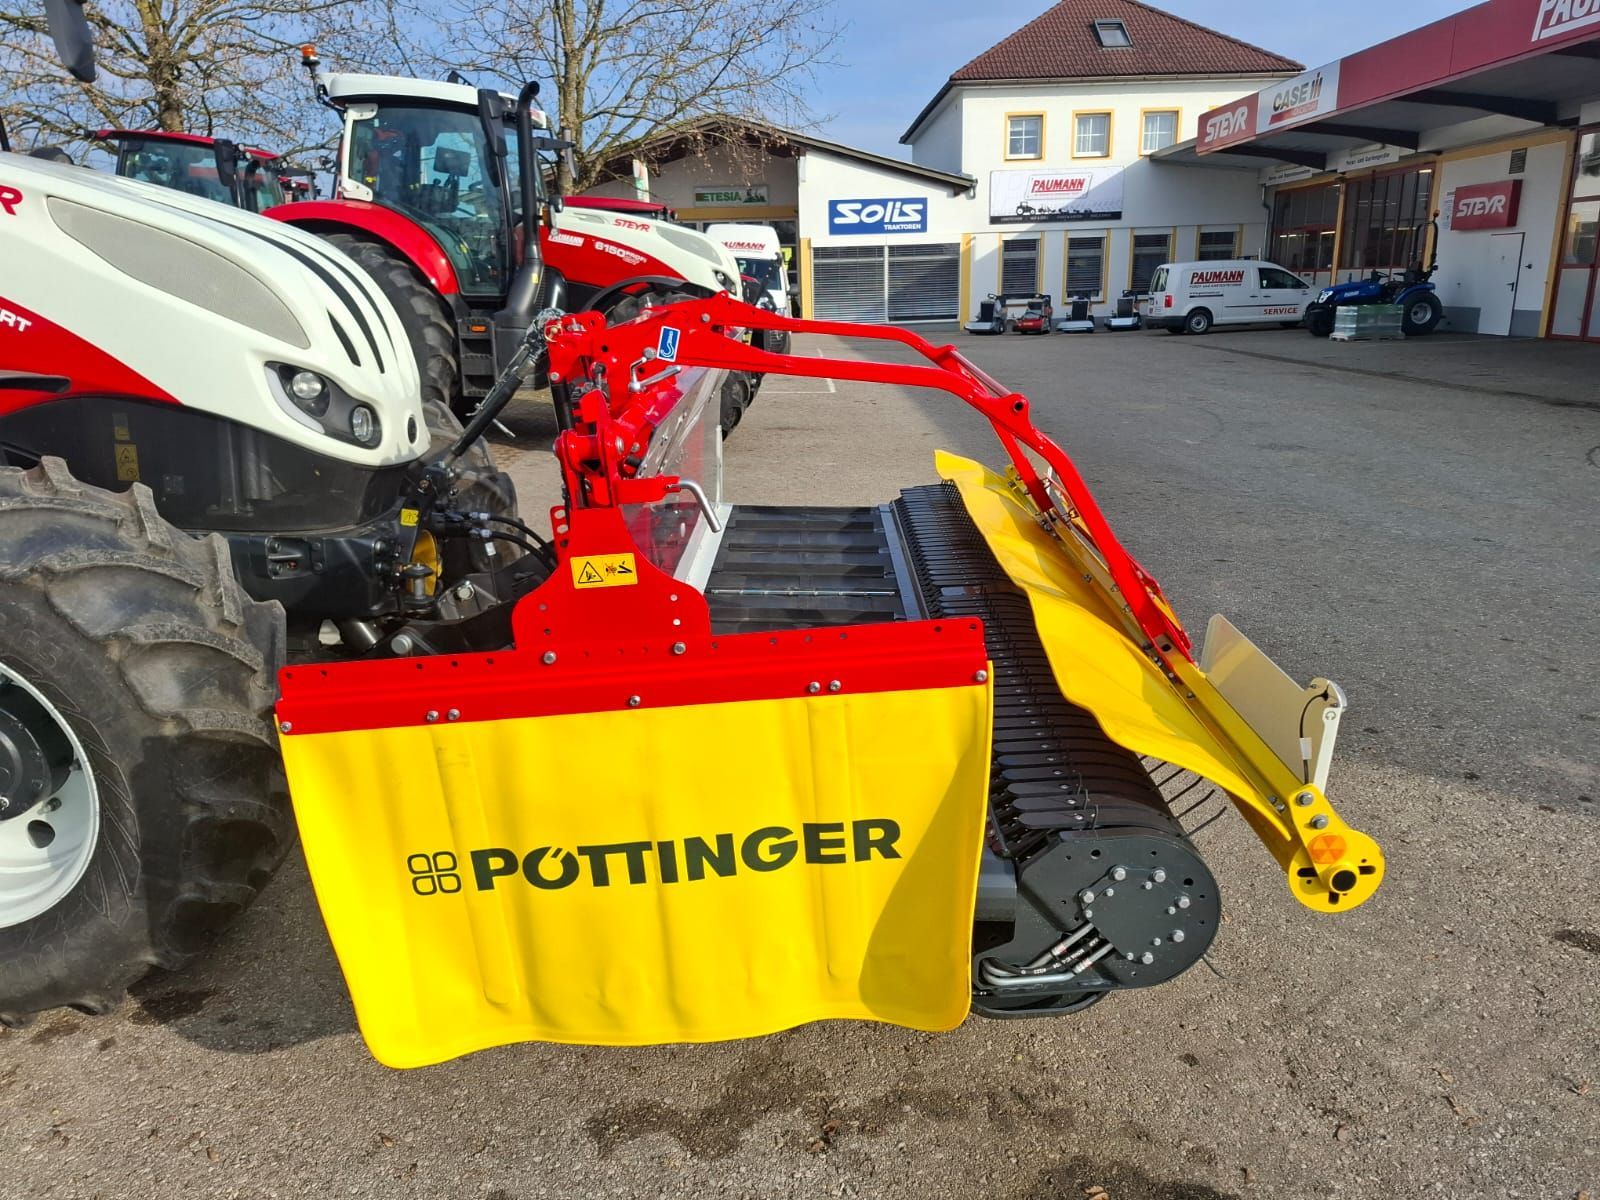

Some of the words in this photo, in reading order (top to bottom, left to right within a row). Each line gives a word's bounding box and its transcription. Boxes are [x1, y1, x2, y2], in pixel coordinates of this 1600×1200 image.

[1273, 82, 1309, 112] CASE
[1204, 106, 1248, 143] STEYR
[1031, 178, 1086, 193] PAUMANN
[696, 191, 741, 202] ETESIA
[1456, 194, 1506, 217] STEYR
[614, 218, 650, 232] STEYR
[883, 223, 921, 231] TRAKTOREN
[594, 241, 625, 258] 6150
[1190, 270, 1244, 284] PAUMANN
[1264, 307, 1297, 315] SERVICE
[470, 819, 903, 891] PÖTTINGER
